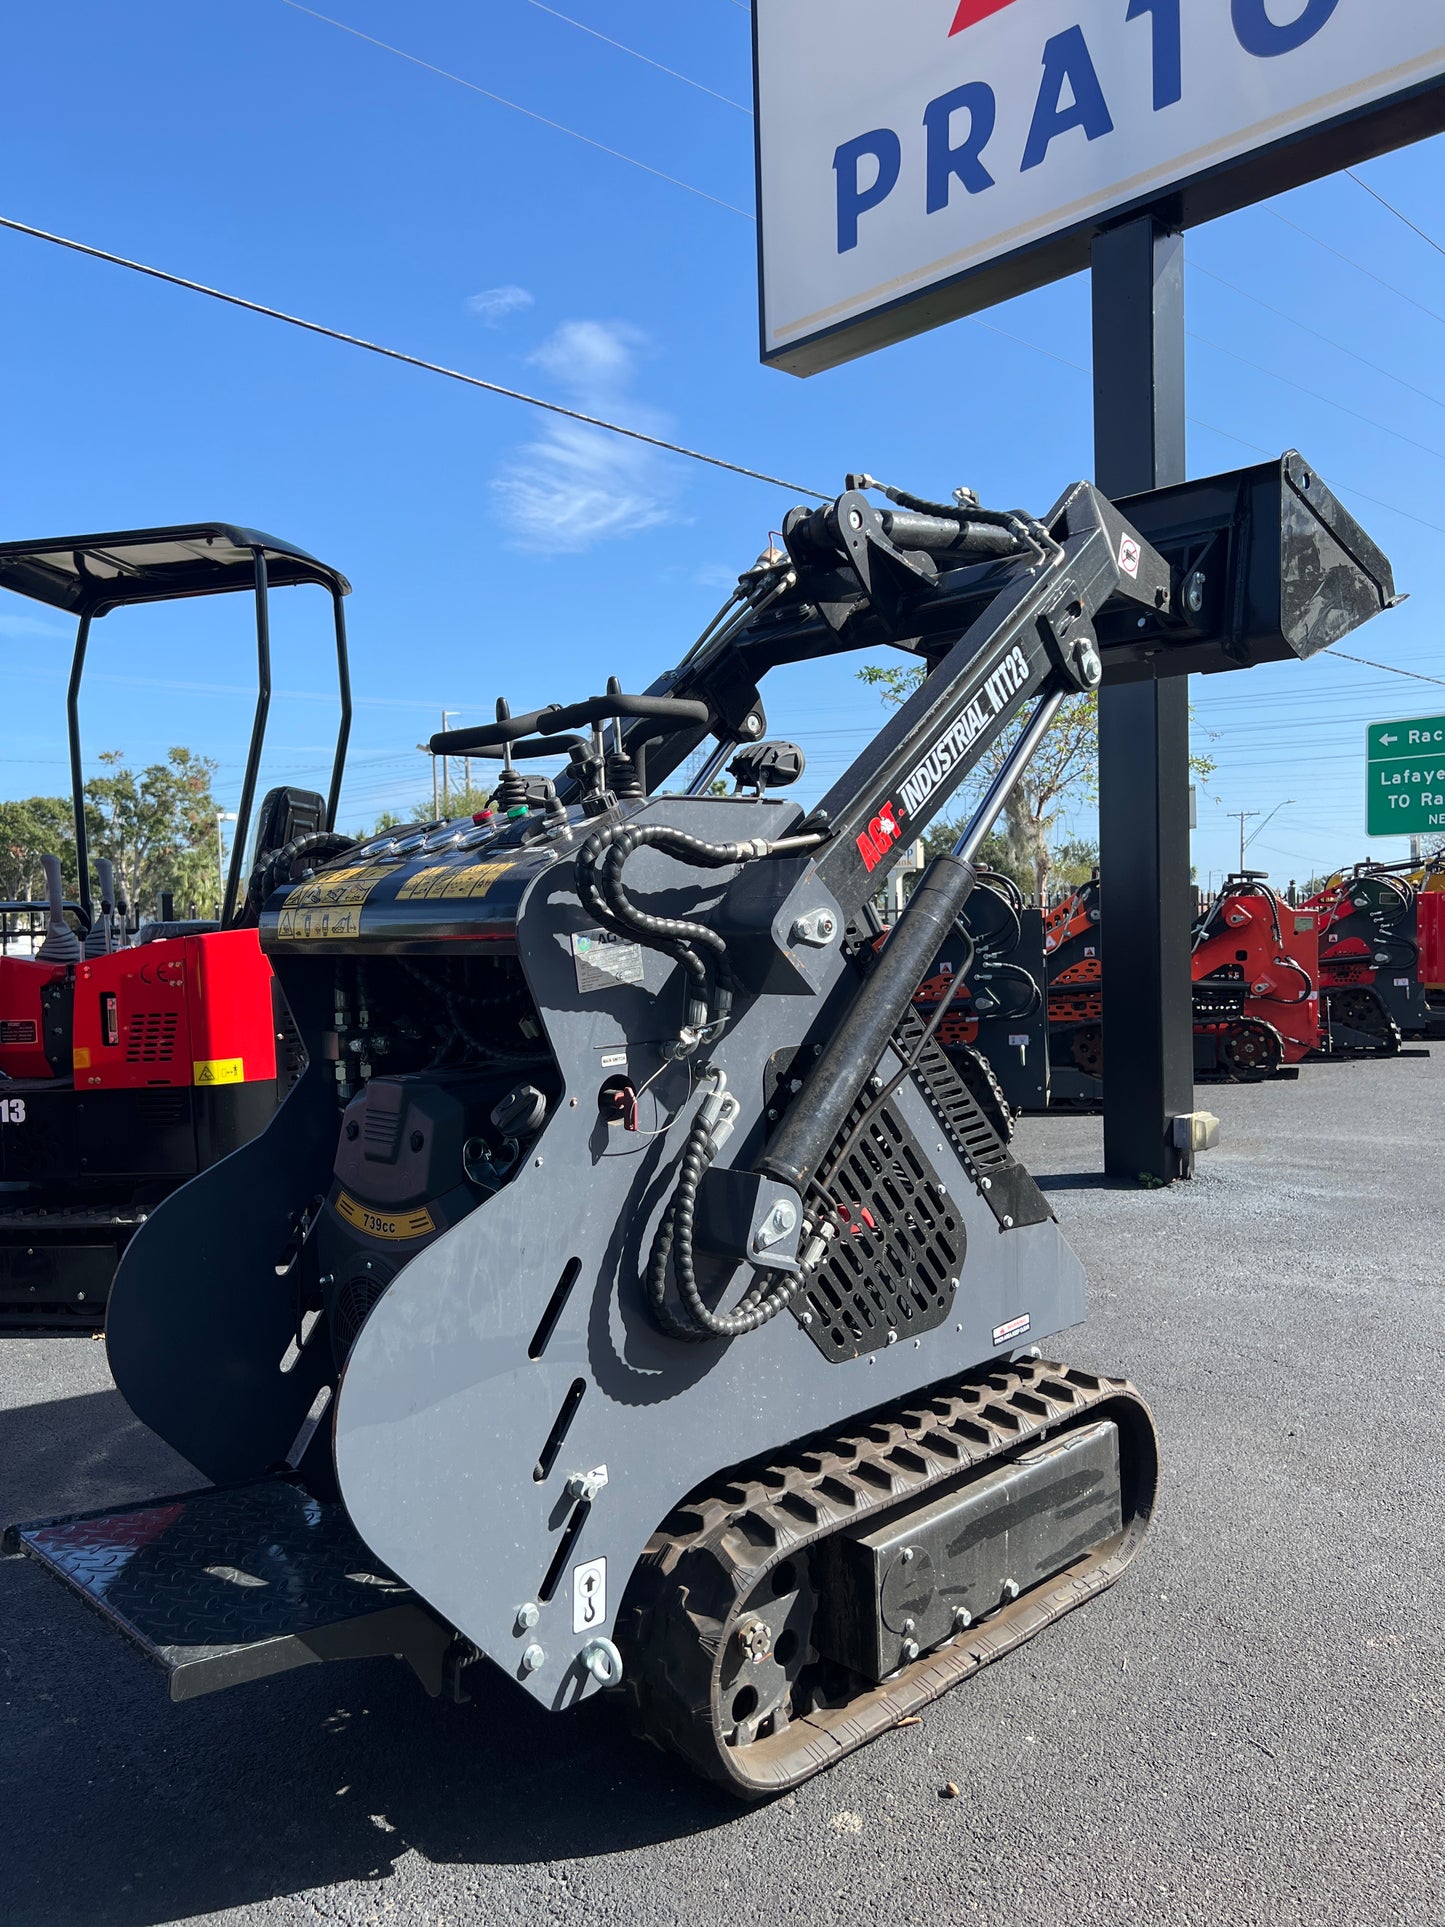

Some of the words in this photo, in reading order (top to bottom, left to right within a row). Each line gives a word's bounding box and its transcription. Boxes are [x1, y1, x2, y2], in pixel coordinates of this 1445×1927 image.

[900, 700, 989, 815] INDUSTRIAL
[984, 645, 1030, 714] KTT23
[1381, 769, 1445, 786] Lafaye
[1388, 794, 1410, 809] TO
[1421, 792, 1444, 807] Ra
[0, 1099, 26, 1123] 13
[363, 1213, 396, 1233] 739cc
